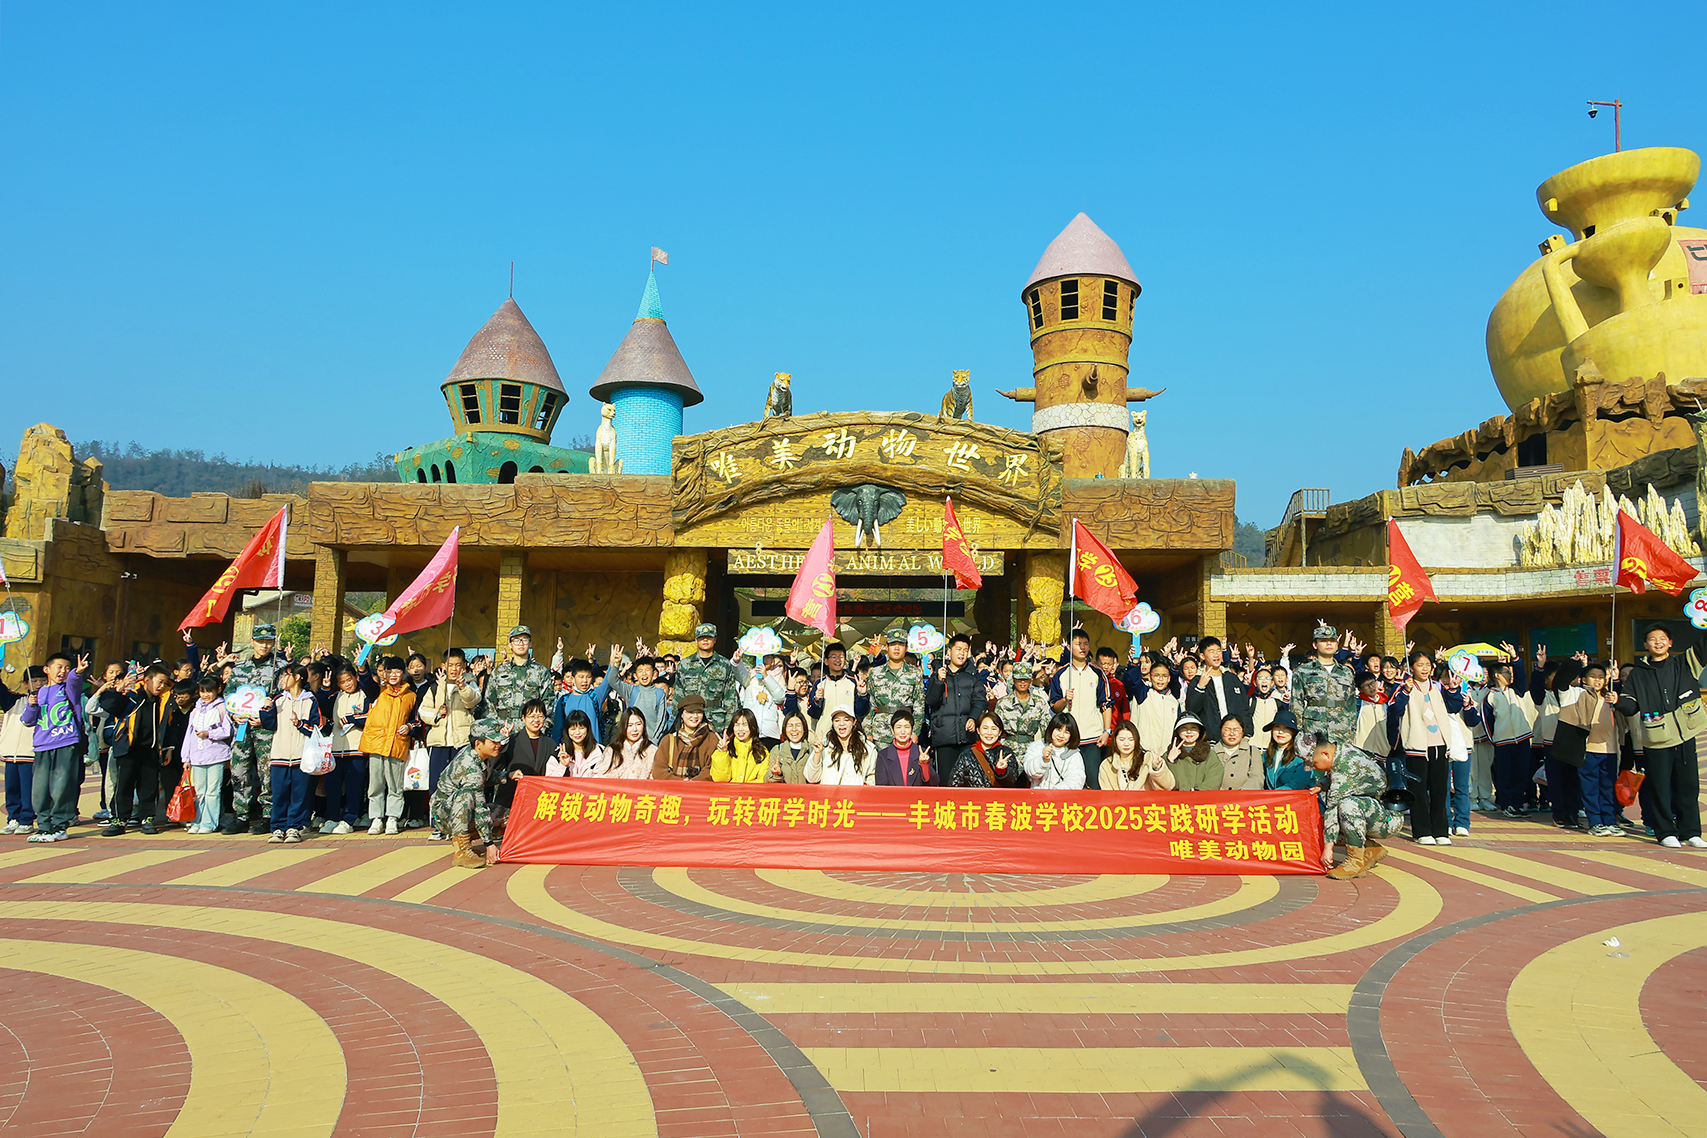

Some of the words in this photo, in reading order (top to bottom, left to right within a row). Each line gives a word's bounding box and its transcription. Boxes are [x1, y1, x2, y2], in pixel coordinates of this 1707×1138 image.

[708, 427, 1030, 486] 唯美动物世界
[741, 517, 773, 533] 아름다운
[905, 516, 982, 534] 美しい動世界
[733, 555, 806, 569] AESTHE
[846, 556, 921, 570] ANIMAL
[1130, 609, 1142, 625] 6
[370, 620, 384, 636] 3
[754, 633, 765, 648] 4
[917, 631, 928, 646] 5
[1463, 656, 1471, 671] 7
[241, 692, 255, 709] 2
[1169, 839, 1306, 862] 唯美动物园
